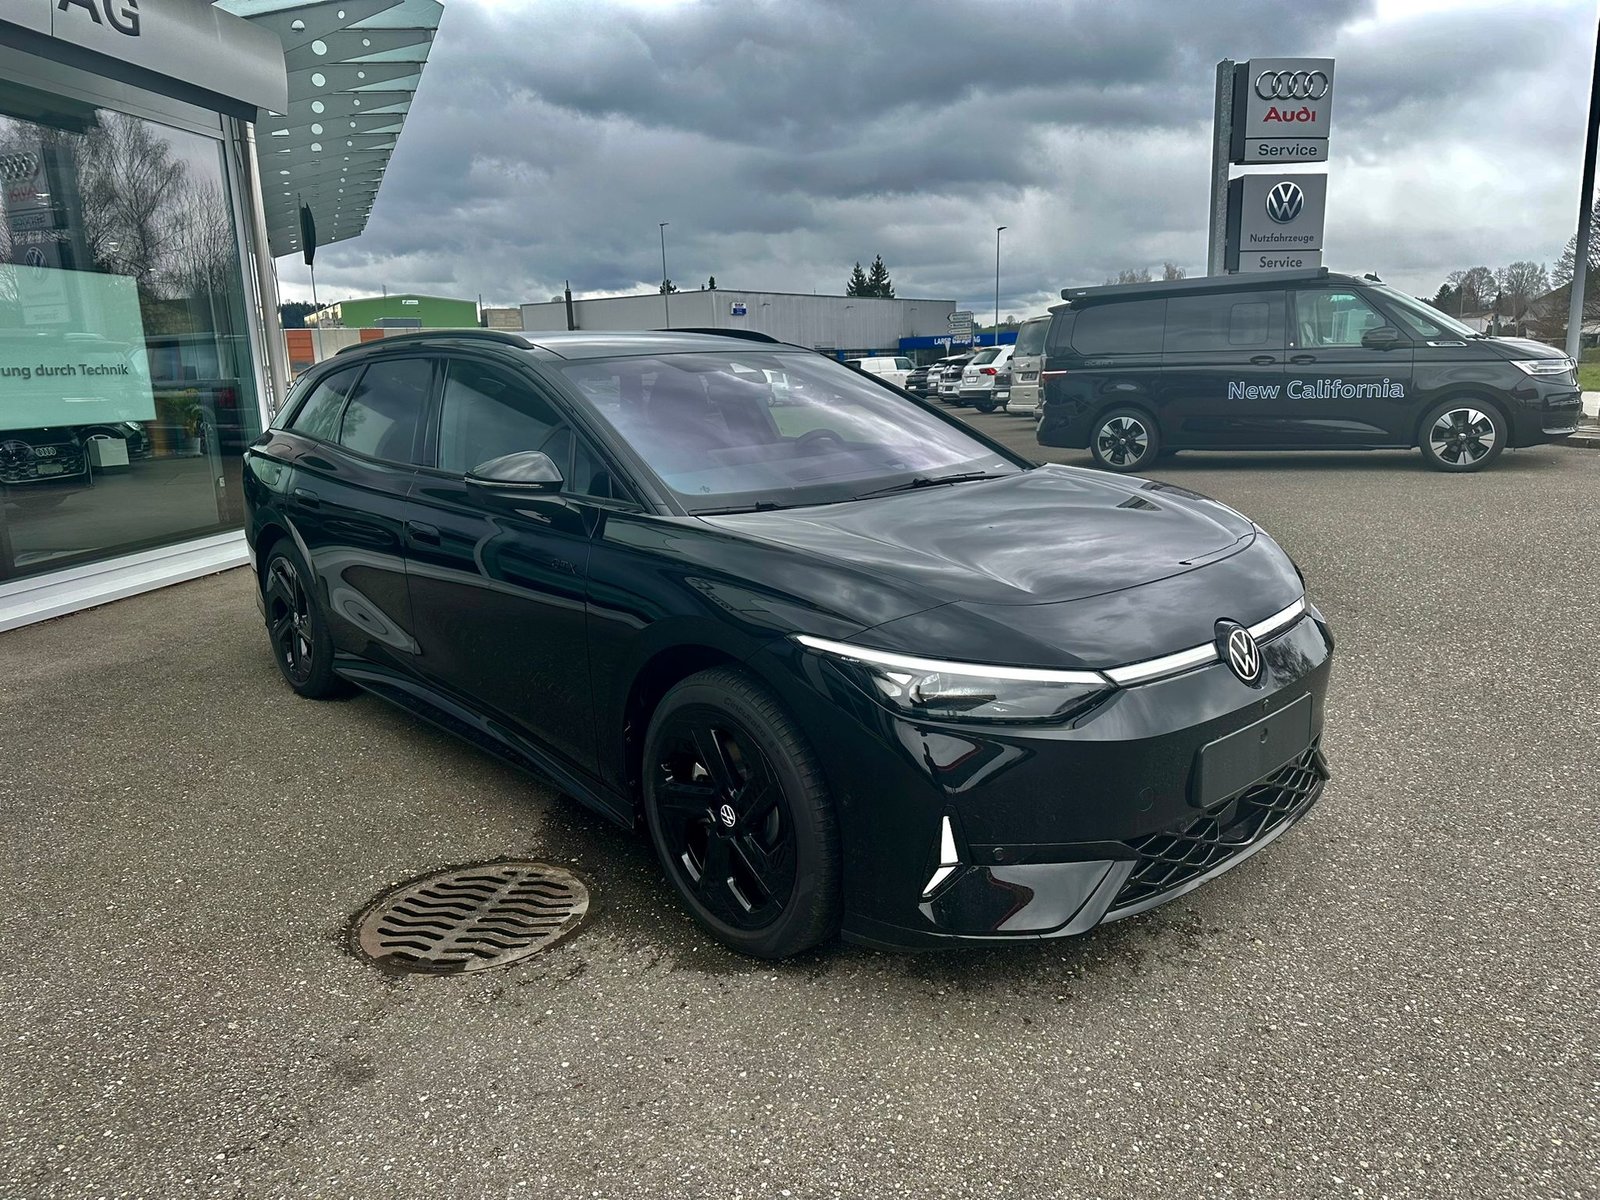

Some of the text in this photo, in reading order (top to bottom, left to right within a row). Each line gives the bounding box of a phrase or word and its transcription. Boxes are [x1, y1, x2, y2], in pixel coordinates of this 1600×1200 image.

[1262, 106, 1316, 122] Audi
[1258, 143, 1318, 156] Service
[1250, 233, 1315, 244] Nutzfahrzeuge
[1259, 256, 1303, 268] Service
[1, 363, 129, 380] ung durch Technik
[1227, 378, 1405, 400] New California
